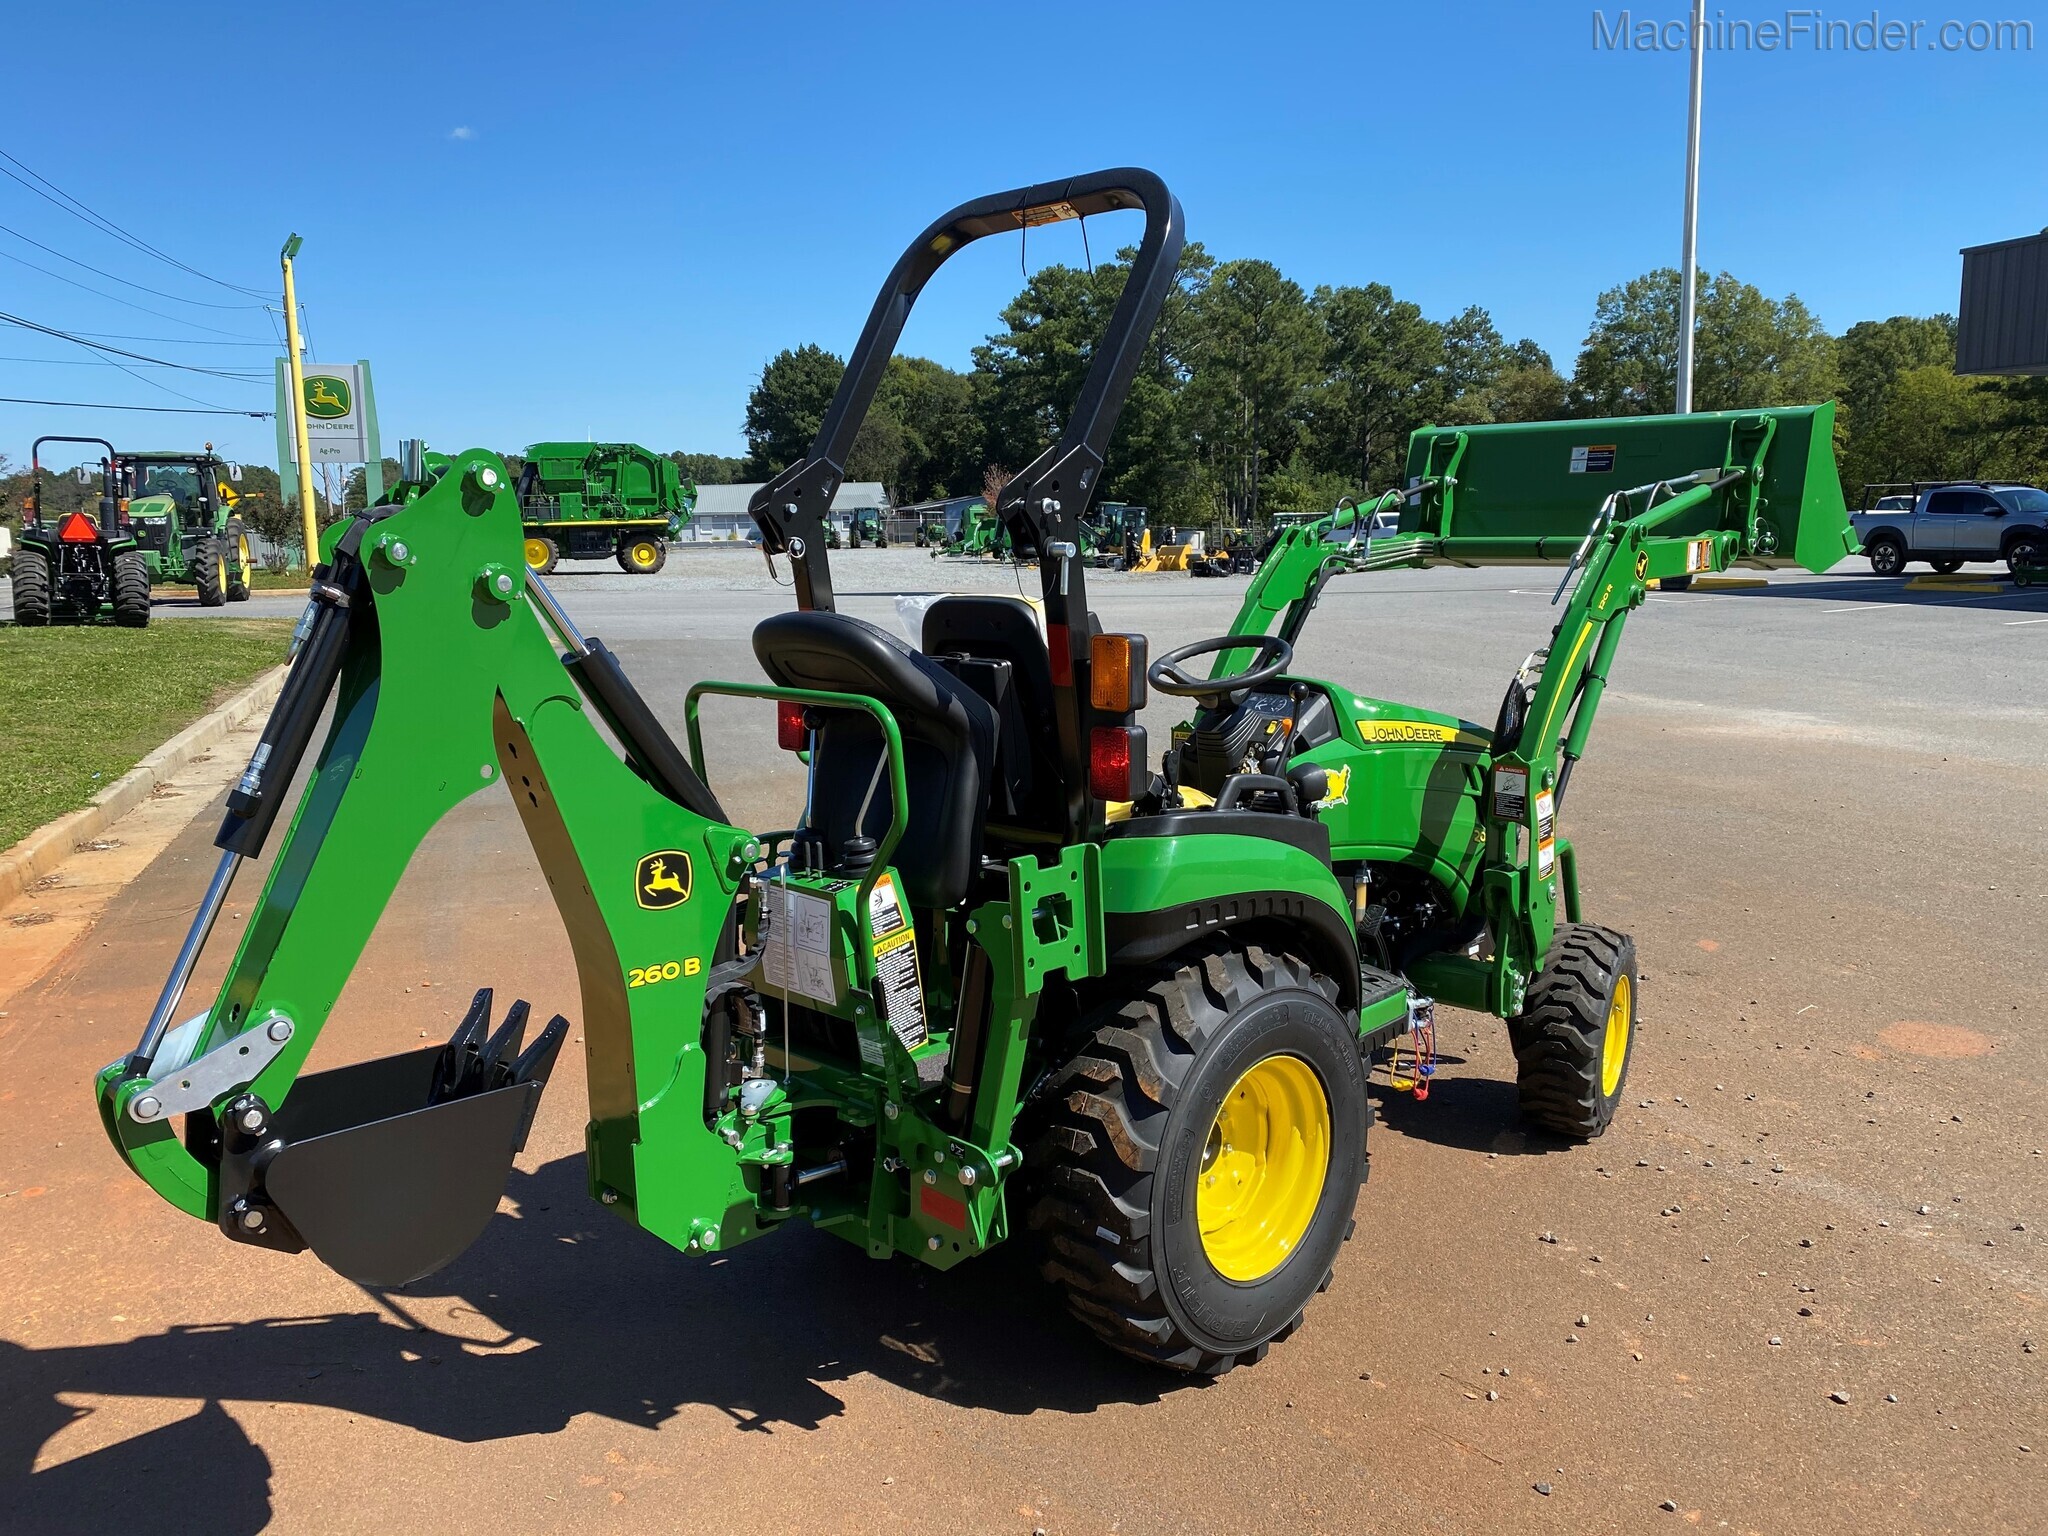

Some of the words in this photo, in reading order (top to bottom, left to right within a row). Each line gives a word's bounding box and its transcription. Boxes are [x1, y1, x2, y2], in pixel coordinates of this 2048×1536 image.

[319, 447, 341, 455] Ag-Pro
[1371, 726, 1404, 740] JOHN
[1405, 726, 1444, 740] DEERE
[882, 932, 910, 951] CAUTION
[628, 960, 681, 988] 260
[684, 956, 701, 977] B
